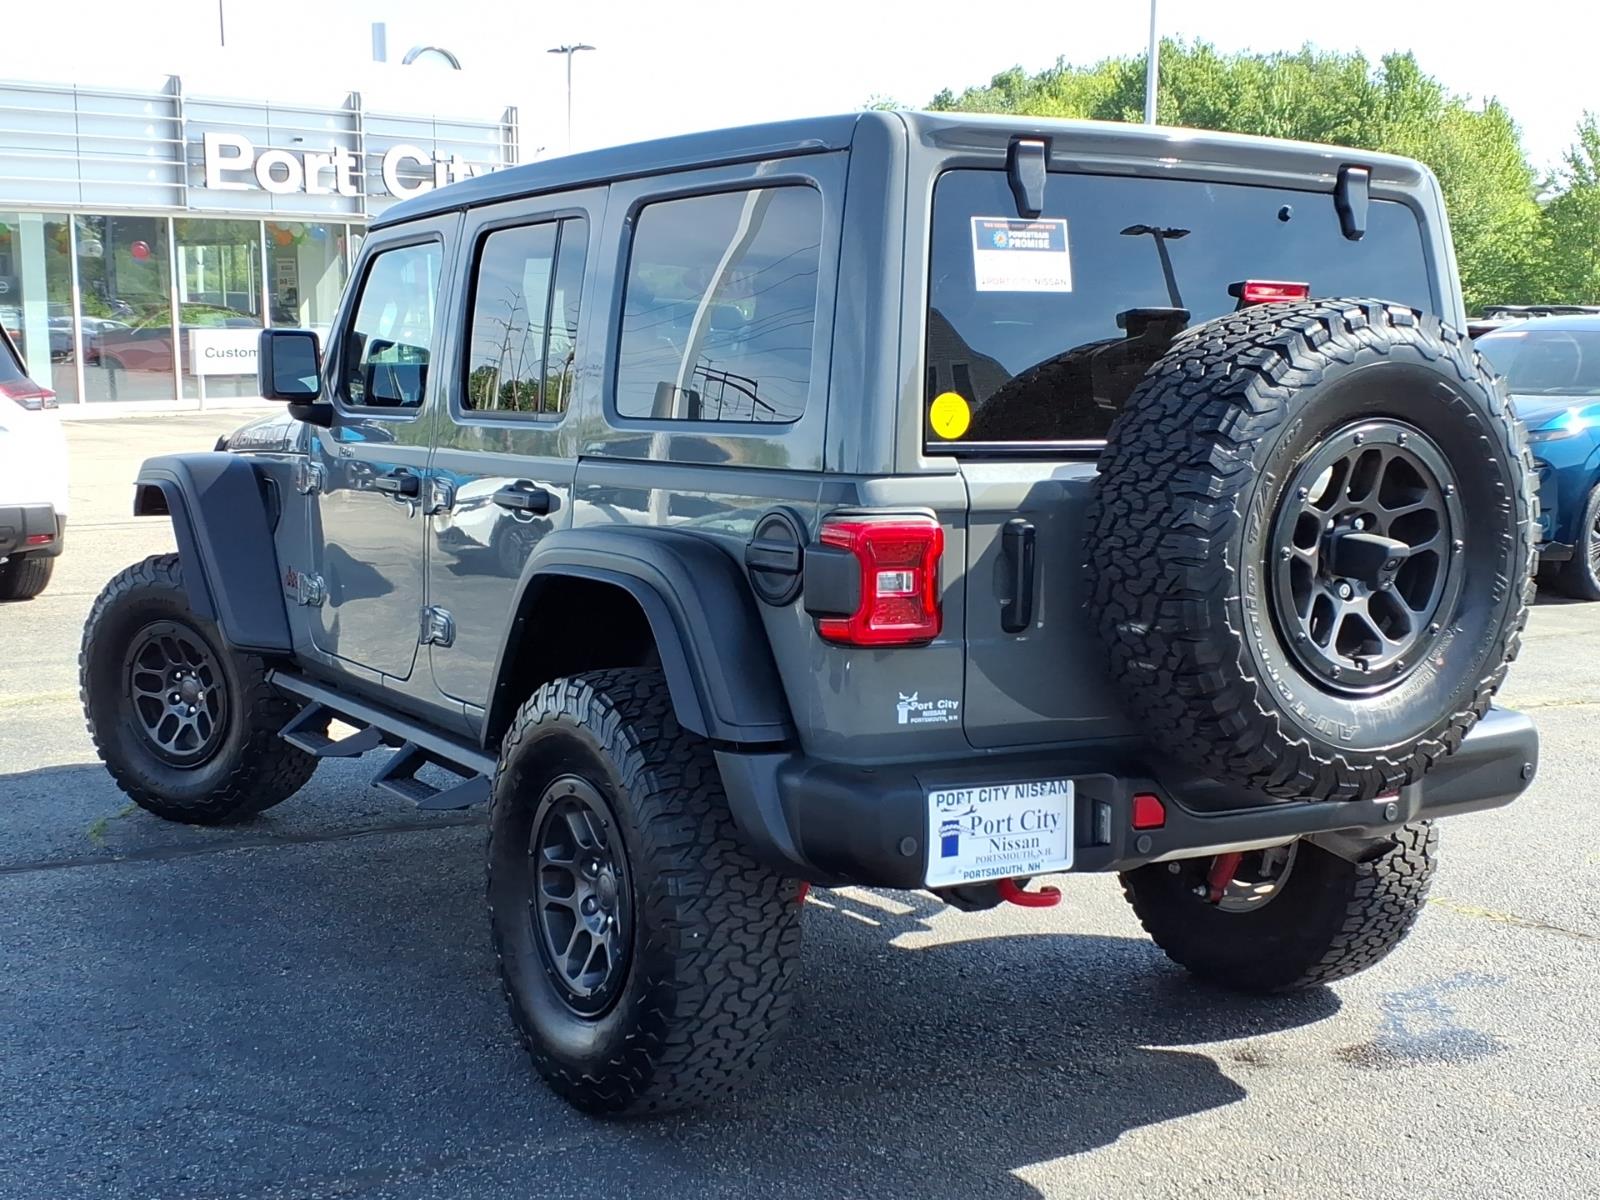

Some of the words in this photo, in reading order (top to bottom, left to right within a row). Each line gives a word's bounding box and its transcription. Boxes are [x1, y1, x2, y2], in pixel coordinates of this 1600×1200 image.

[203, 132, 359, 197] Port
[382, 143, 506, 199] Cit
[1008, 238, 1050, 249] PROMISE
[1033, 278, 1067, 287] NISSAN
[911, 701, 934, 710] Port
[937, 699, 959, 710] City
[936, 790, 974, 807] PORT
[979, 786, 1010, 803] CITY
[1015, 780, 1068, 799] NISSAN
[970, 813, 1014, 836] Port
[1020, 809, 1061, 834] City
[989, 836, 1040, 853] Nissan
[1028, 862, 1041, 872] NH
